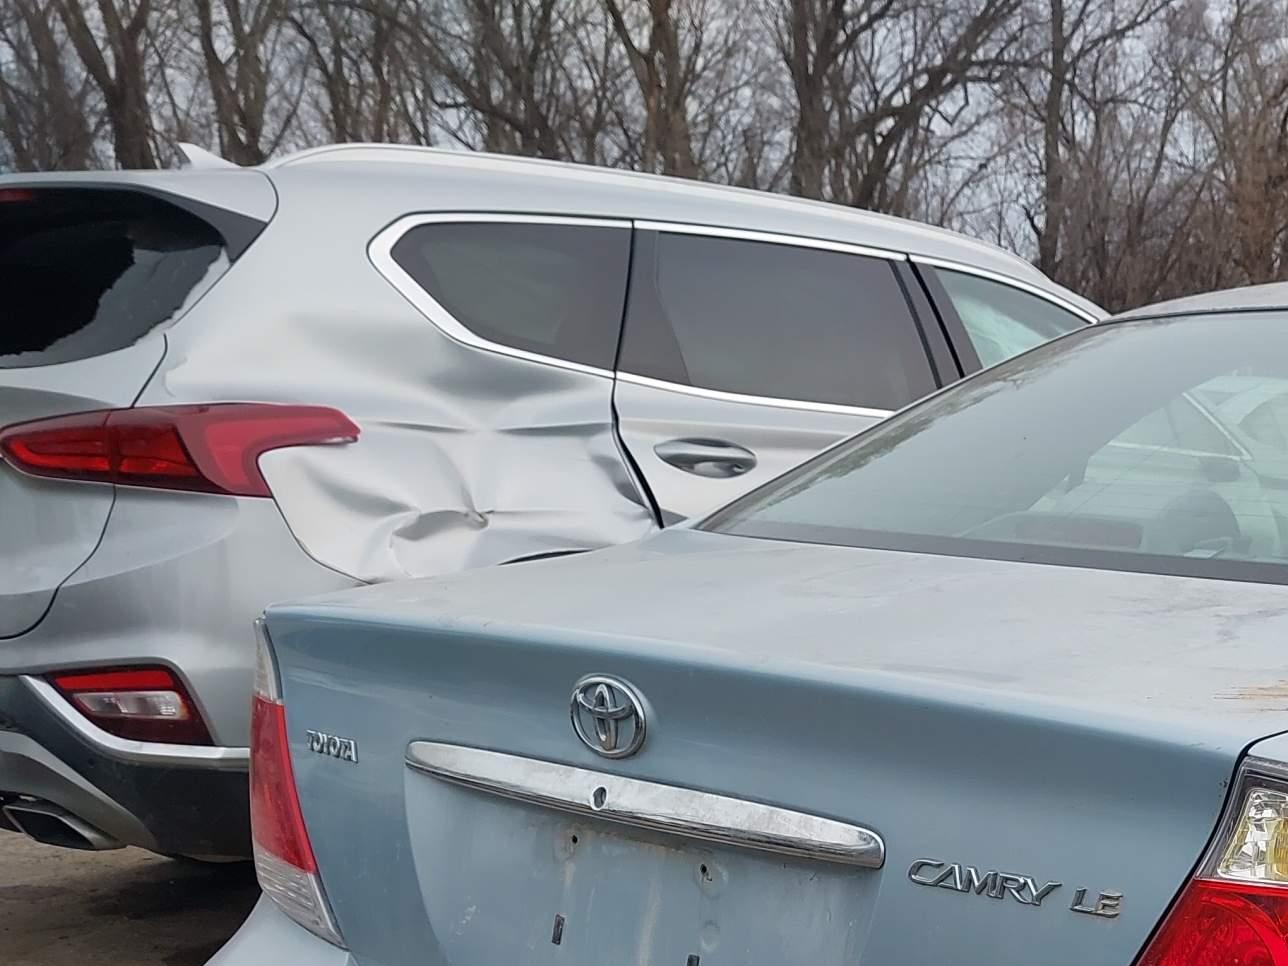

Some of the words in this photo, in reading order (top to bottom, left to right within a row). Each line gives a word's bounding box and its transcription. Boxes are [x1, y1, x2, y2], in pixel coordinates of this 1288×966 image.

[306, 729, 359, 764] TOYOTA
[908, 857, 1063, 907] CAMRY
[1069, 886, 1124, 919] LE
